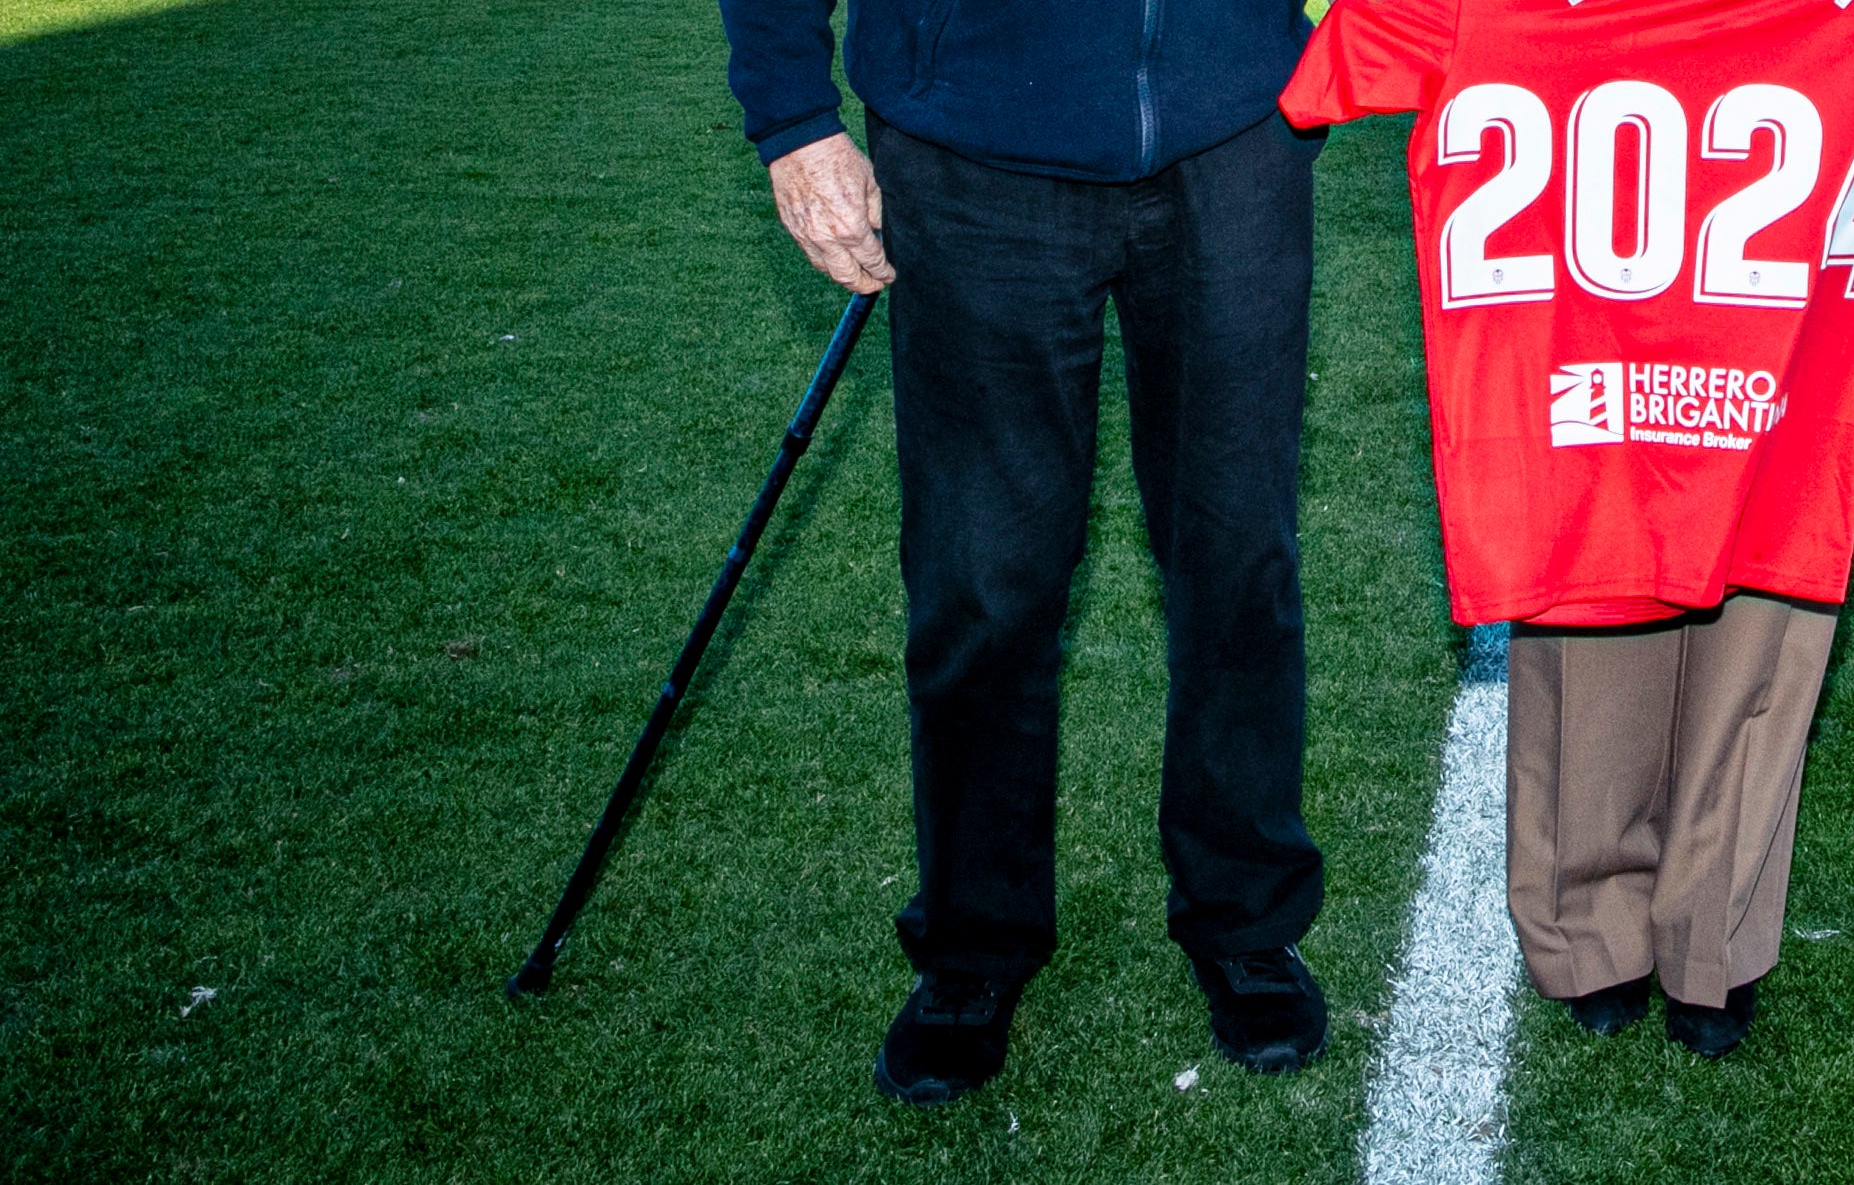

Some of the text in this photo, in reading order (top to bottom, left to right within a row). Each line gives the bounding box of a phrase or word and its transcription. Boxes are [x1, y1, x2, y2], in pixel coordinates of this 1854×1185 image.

[1629, 362, 1776, 402] HERRERO
[1630, 426, 1752, 450] Insurance Broker
